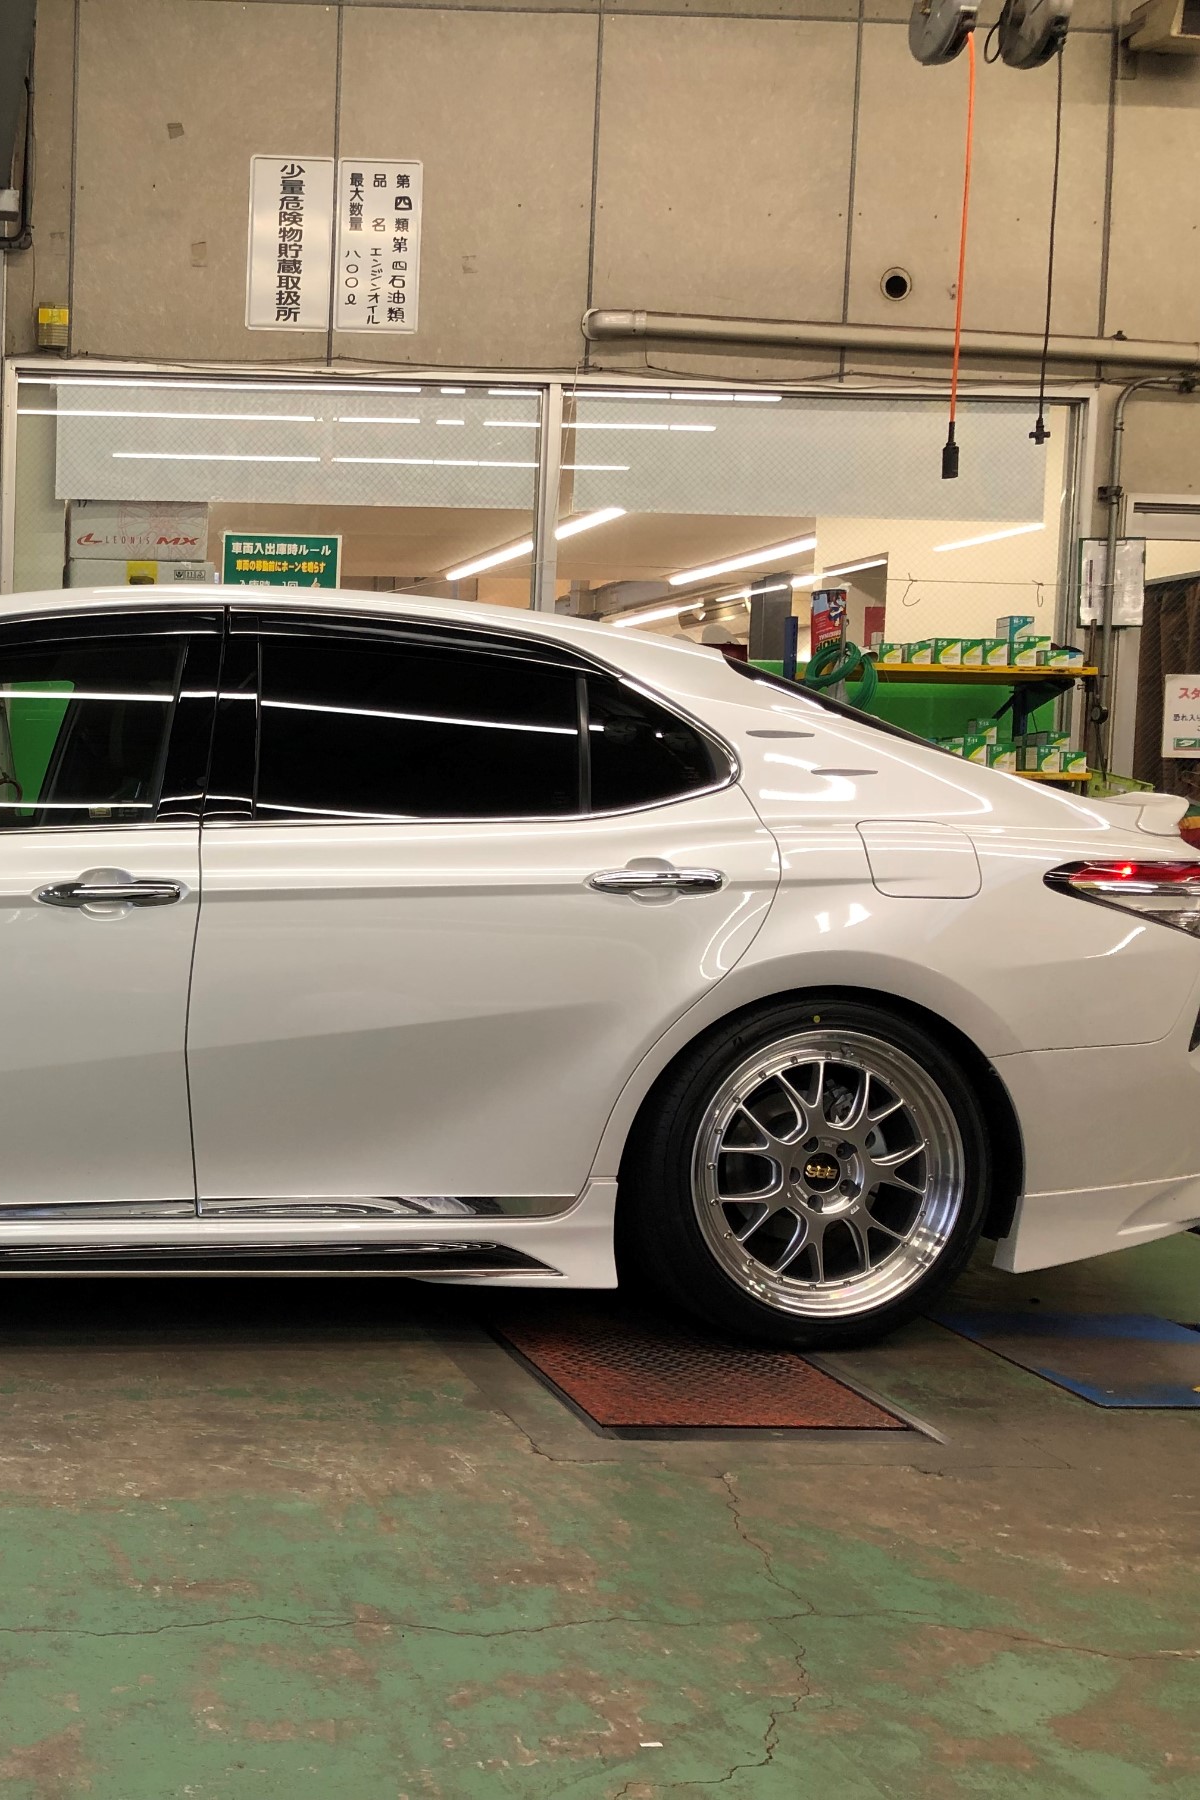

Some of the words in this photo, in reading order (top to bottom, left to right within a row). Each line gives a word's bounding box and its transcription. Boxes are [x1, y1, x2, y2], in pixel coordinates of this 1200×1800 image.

[349, 172, 364, 232] 最大数量
[275, 163, 306, 323] 少量危険物貯蔵取扱所
[105, 535, 150, 545] LEONIS
[156, 536, 199, 545] MX
[231, 542, 332, 556] 車両入出庫時ルール
[235, 559, 327, 574] 車両の移動前にホーンを鳴らす
